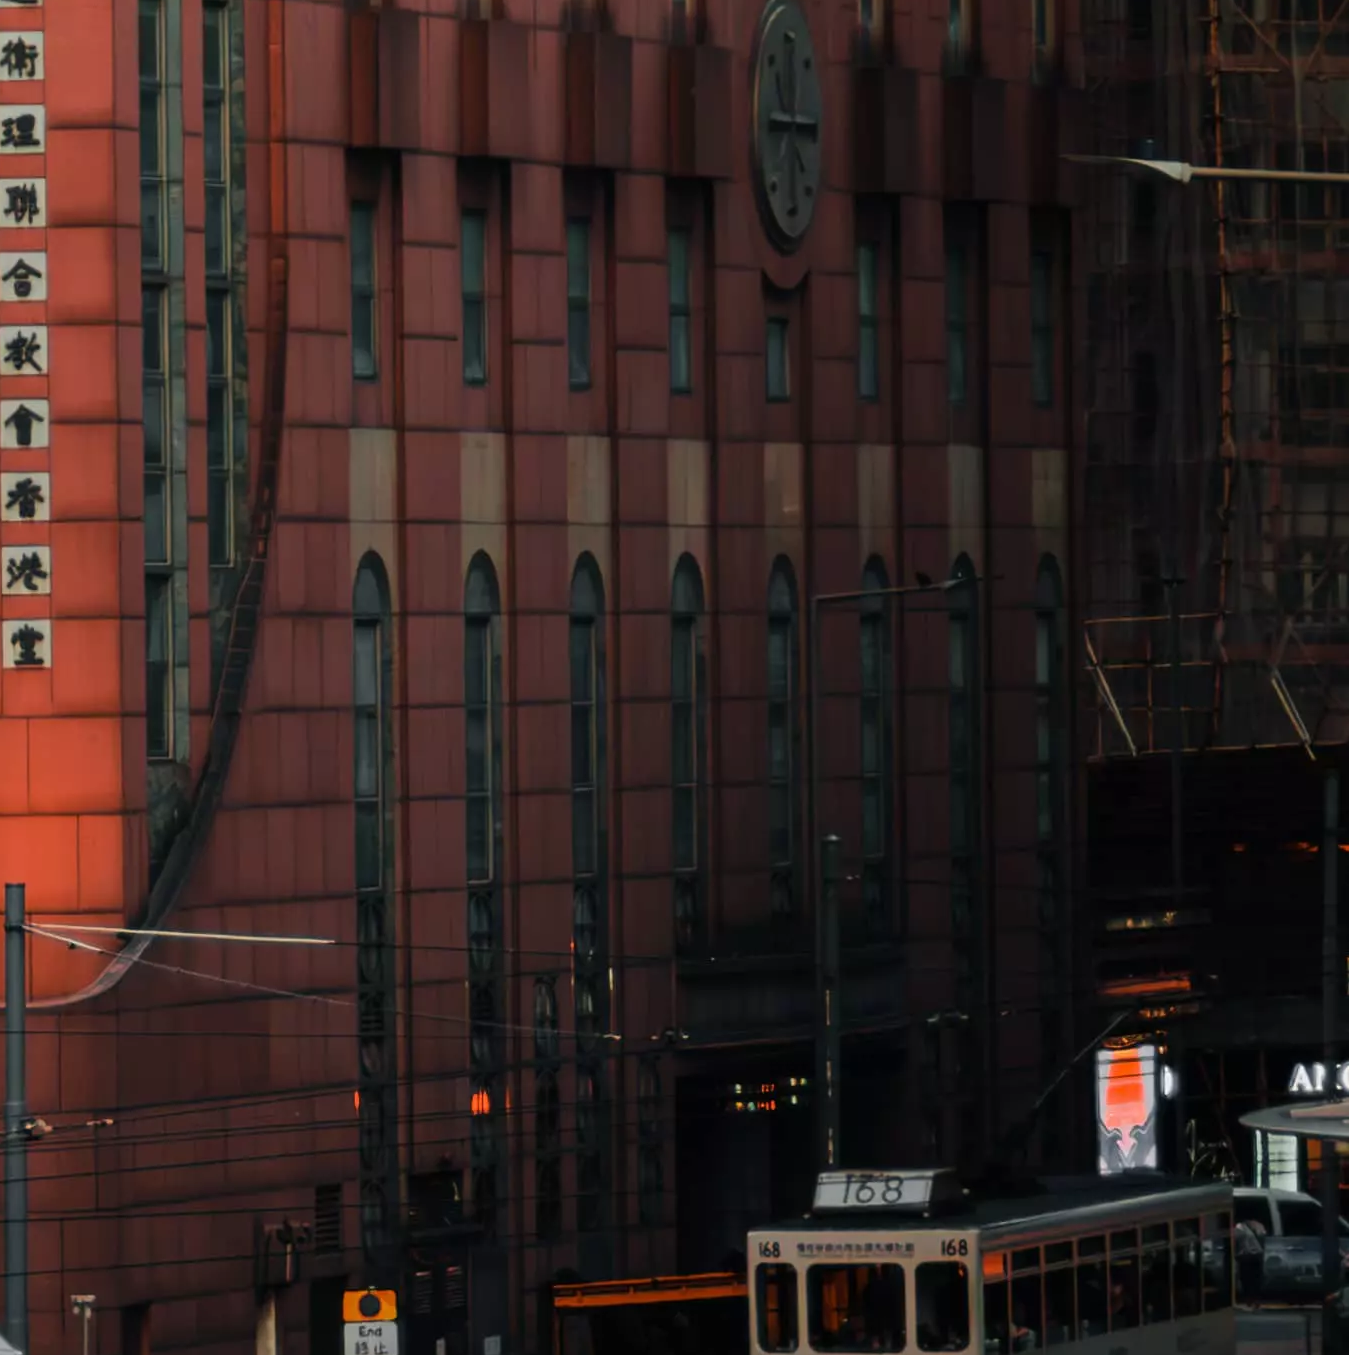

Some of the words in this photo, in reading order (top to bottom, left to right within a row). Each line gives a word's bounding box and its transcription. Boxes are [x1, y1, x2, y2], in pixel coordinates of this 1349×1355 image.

[843, 1174, 904, 1204] 168
[758, 1241, 781, 1258] 168
[941, 1239, 968, 1256] 168
[359, 1326, 382, 1337] End
